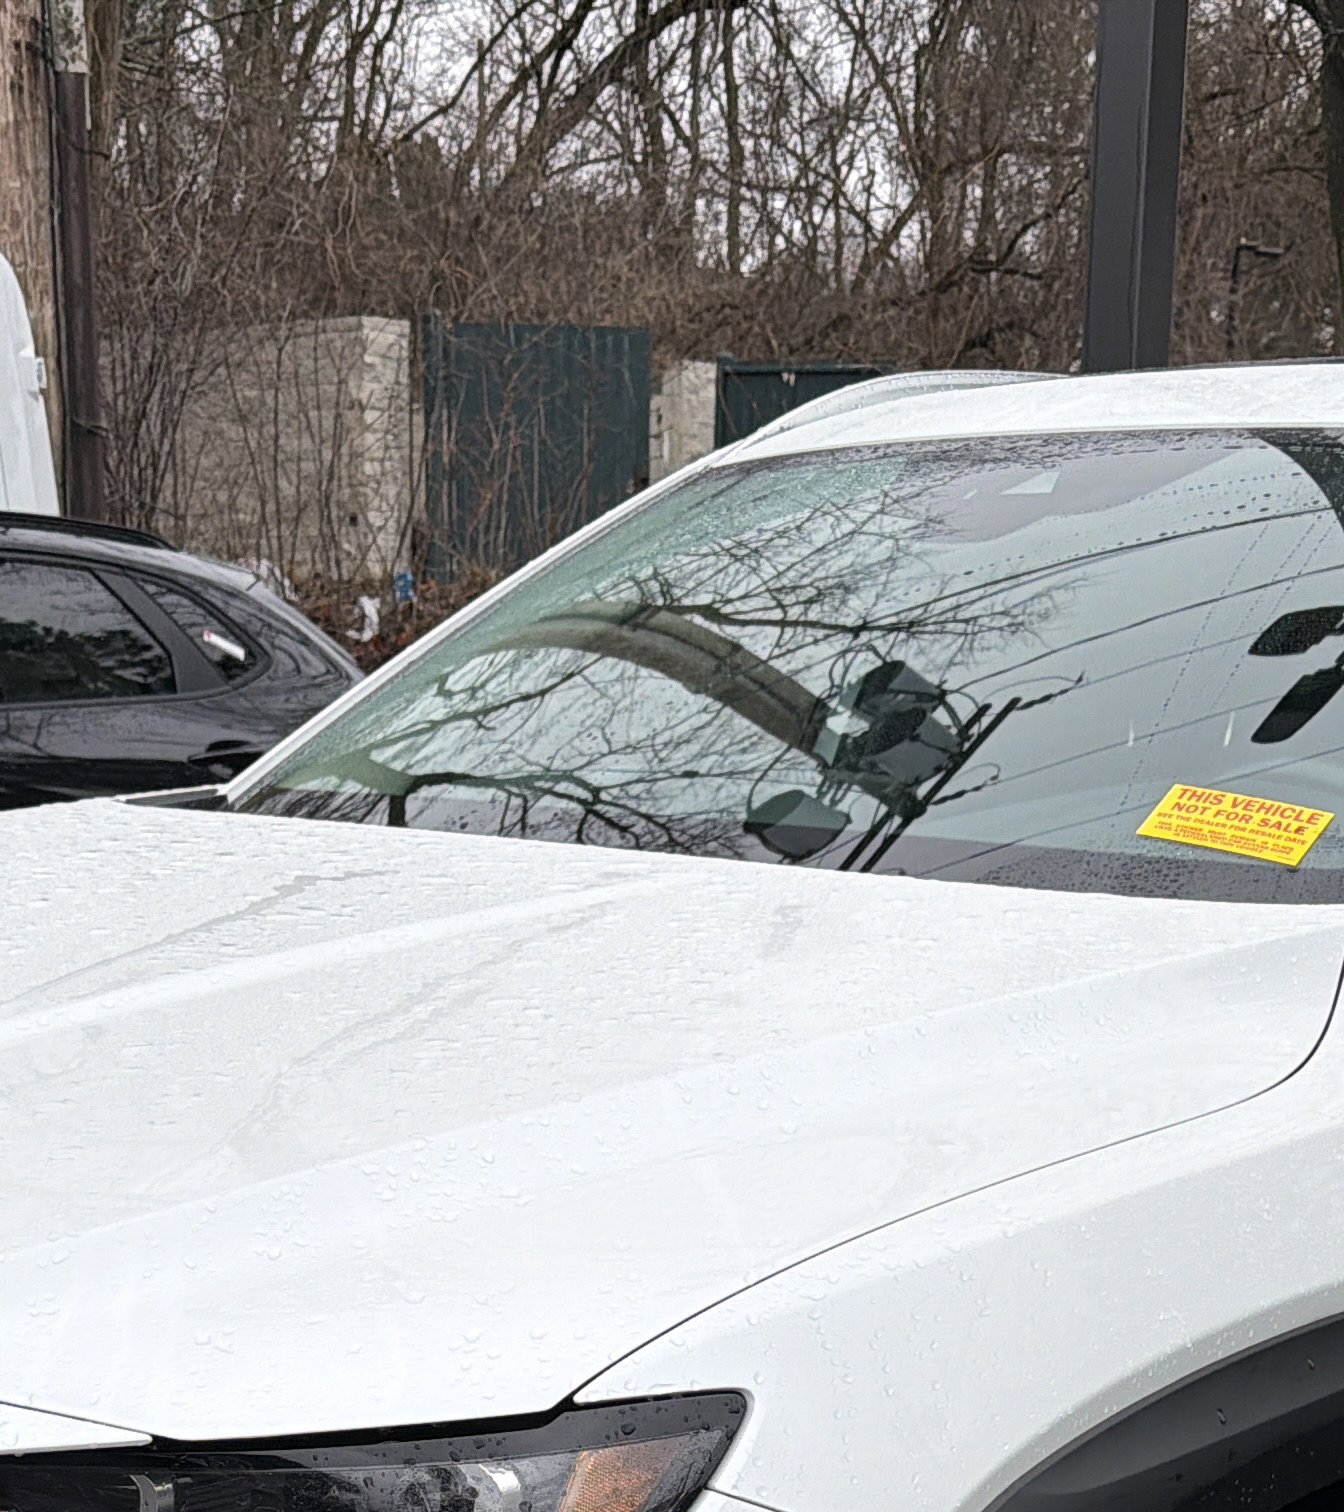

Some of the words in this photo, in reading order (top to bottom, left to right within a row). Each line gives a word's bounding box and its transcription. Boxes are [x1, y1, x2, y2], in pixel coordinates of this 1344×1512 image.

[1170, 801, 1212, 816] NOT
[1213, 808, 1254, 824] FOR
[1257, 817, 1310, 836] SALE
[1176, 788, 1227, 806] THIS
[1230, 796, 1324, 826] VEHICLE
